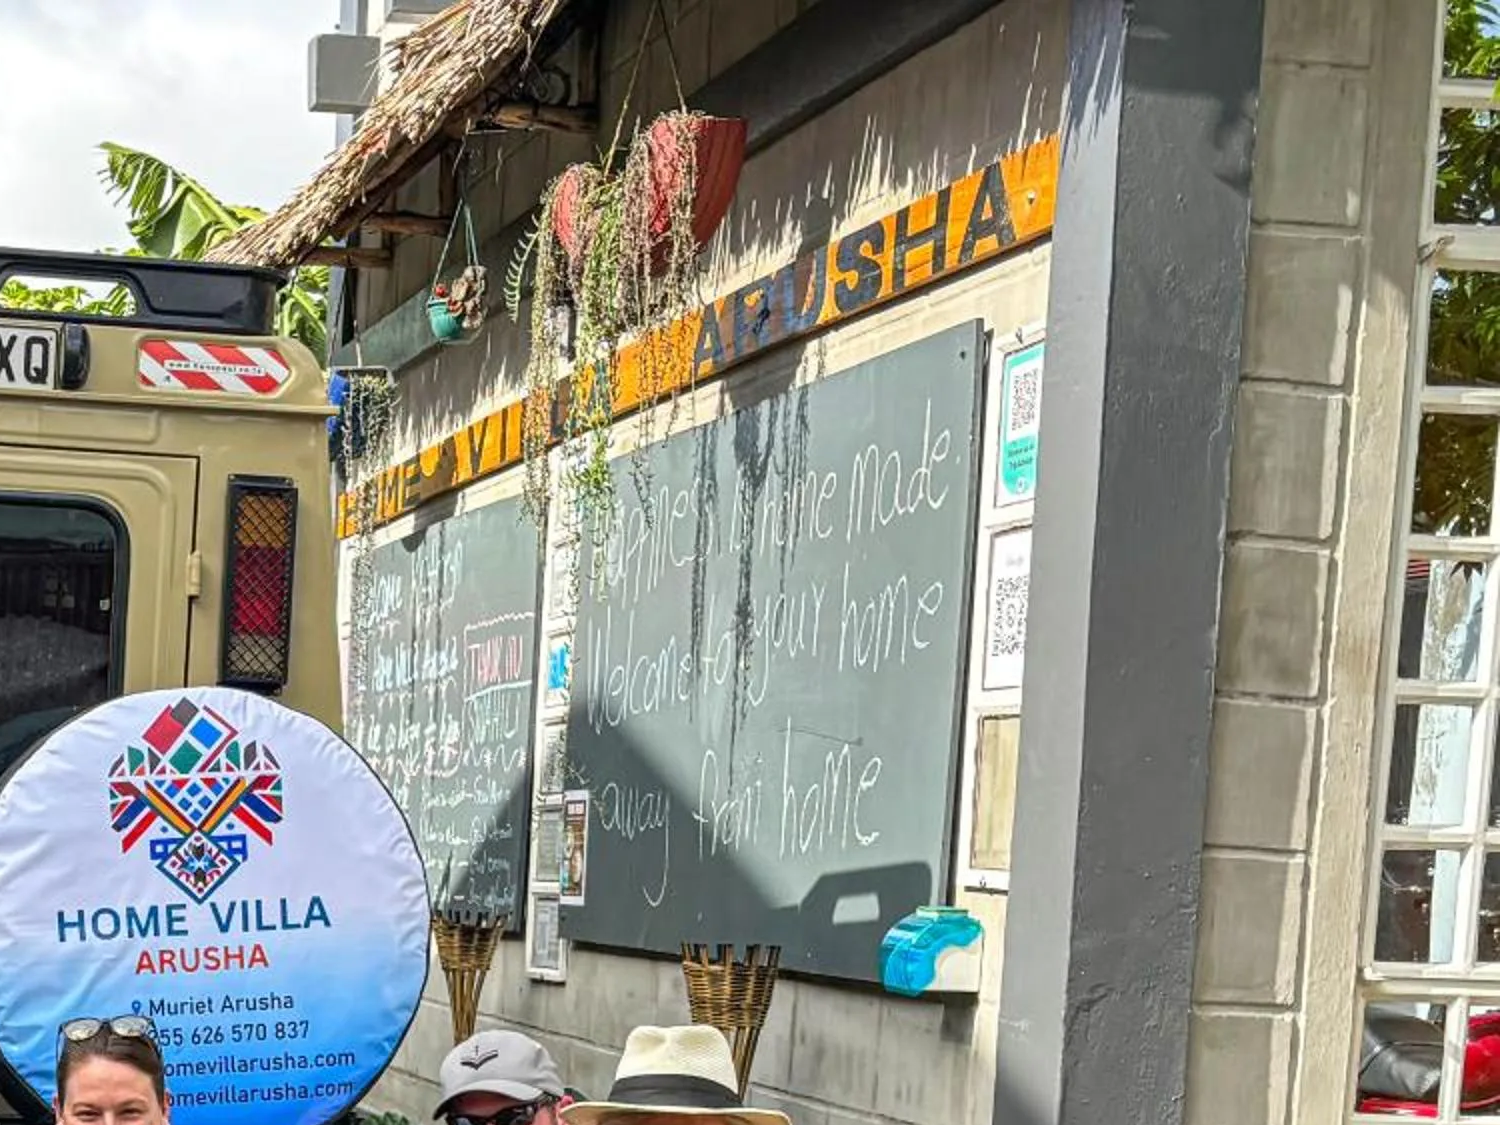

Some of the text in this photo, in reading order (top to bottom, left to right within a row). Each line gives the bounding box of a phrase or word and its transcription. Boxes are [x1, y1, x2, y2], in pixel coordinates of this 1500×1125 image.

[694, 161, 1020, 374] ARUSHA
[56, 895, 332, 943] HOME VILLA
[135, 945, 269, 976] ARUSHA
[149, 992, 294, 1017] Muriet Arusha
[191, 1026, 225, 1046] 626
[231, 1023, 267, 1043] 570
[275, 1020, 310, 1040] 837
